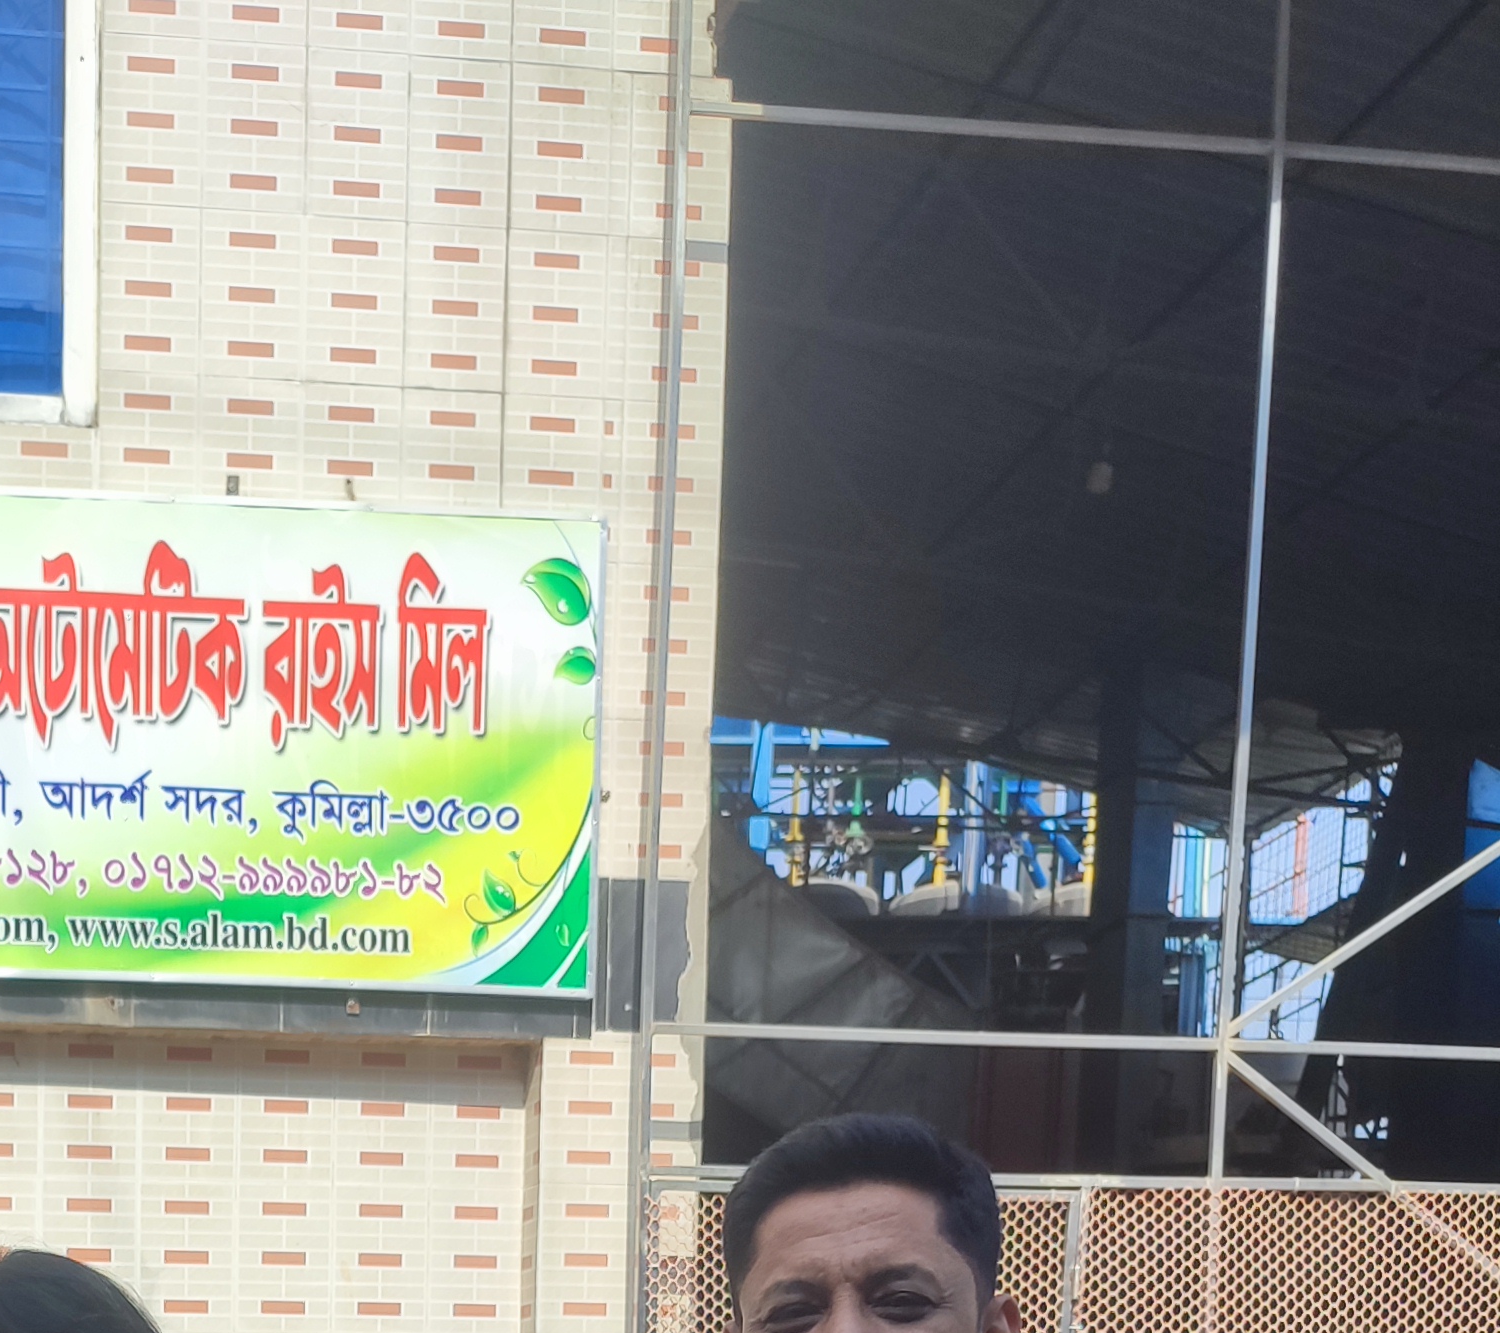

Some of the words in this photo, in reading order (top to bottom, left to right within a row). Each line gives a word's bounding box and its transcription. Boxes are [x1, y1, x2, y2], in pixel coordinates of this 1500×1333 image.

[263, 564, 380, 747] রাইস
[397, 552, 487, 732] মিল
[39, 769, 152, 821] আদর্শ
[160, 785, 258, 834] সদর,
[272, 780, 520, 840] কুমিল্লা-৩৫০০
[104, 851, 445, 904] ০১৭১২-৯৯৯৯৮১-৮২
[67, 912, 411, 954] www.s.alam.bd.com
